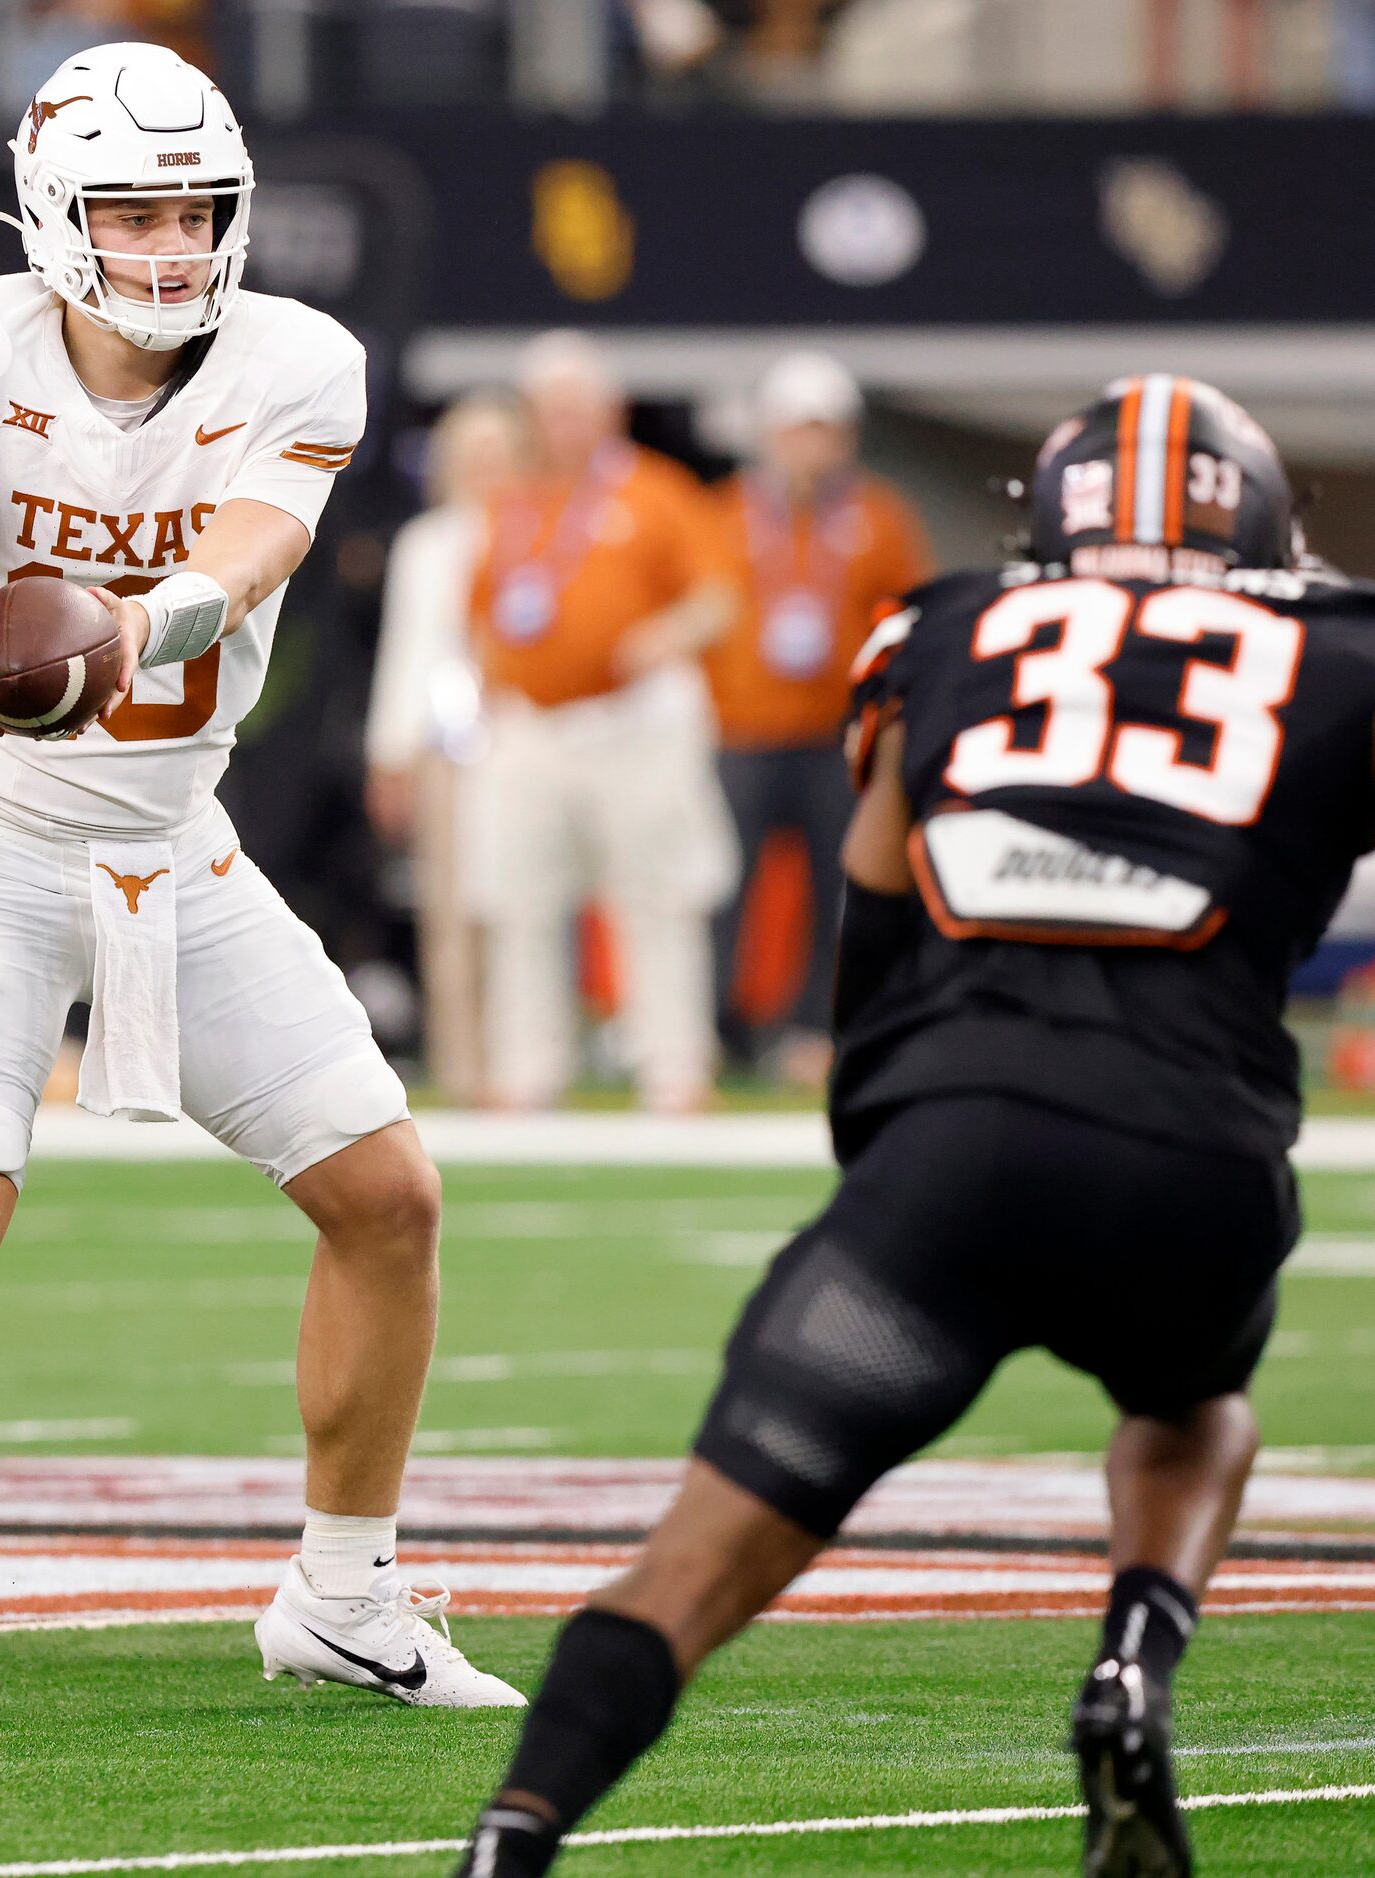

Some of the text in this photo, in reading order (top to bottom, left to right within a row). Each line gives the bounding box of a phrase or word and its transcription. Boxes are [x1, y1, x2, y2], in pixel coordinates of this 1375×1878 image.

[156, 151, 202, 167] HORNS
[2, 399, 57, 440] XII
[1188, 452, 1242, 510] 33
[942, 577, 1306, 827] 33
